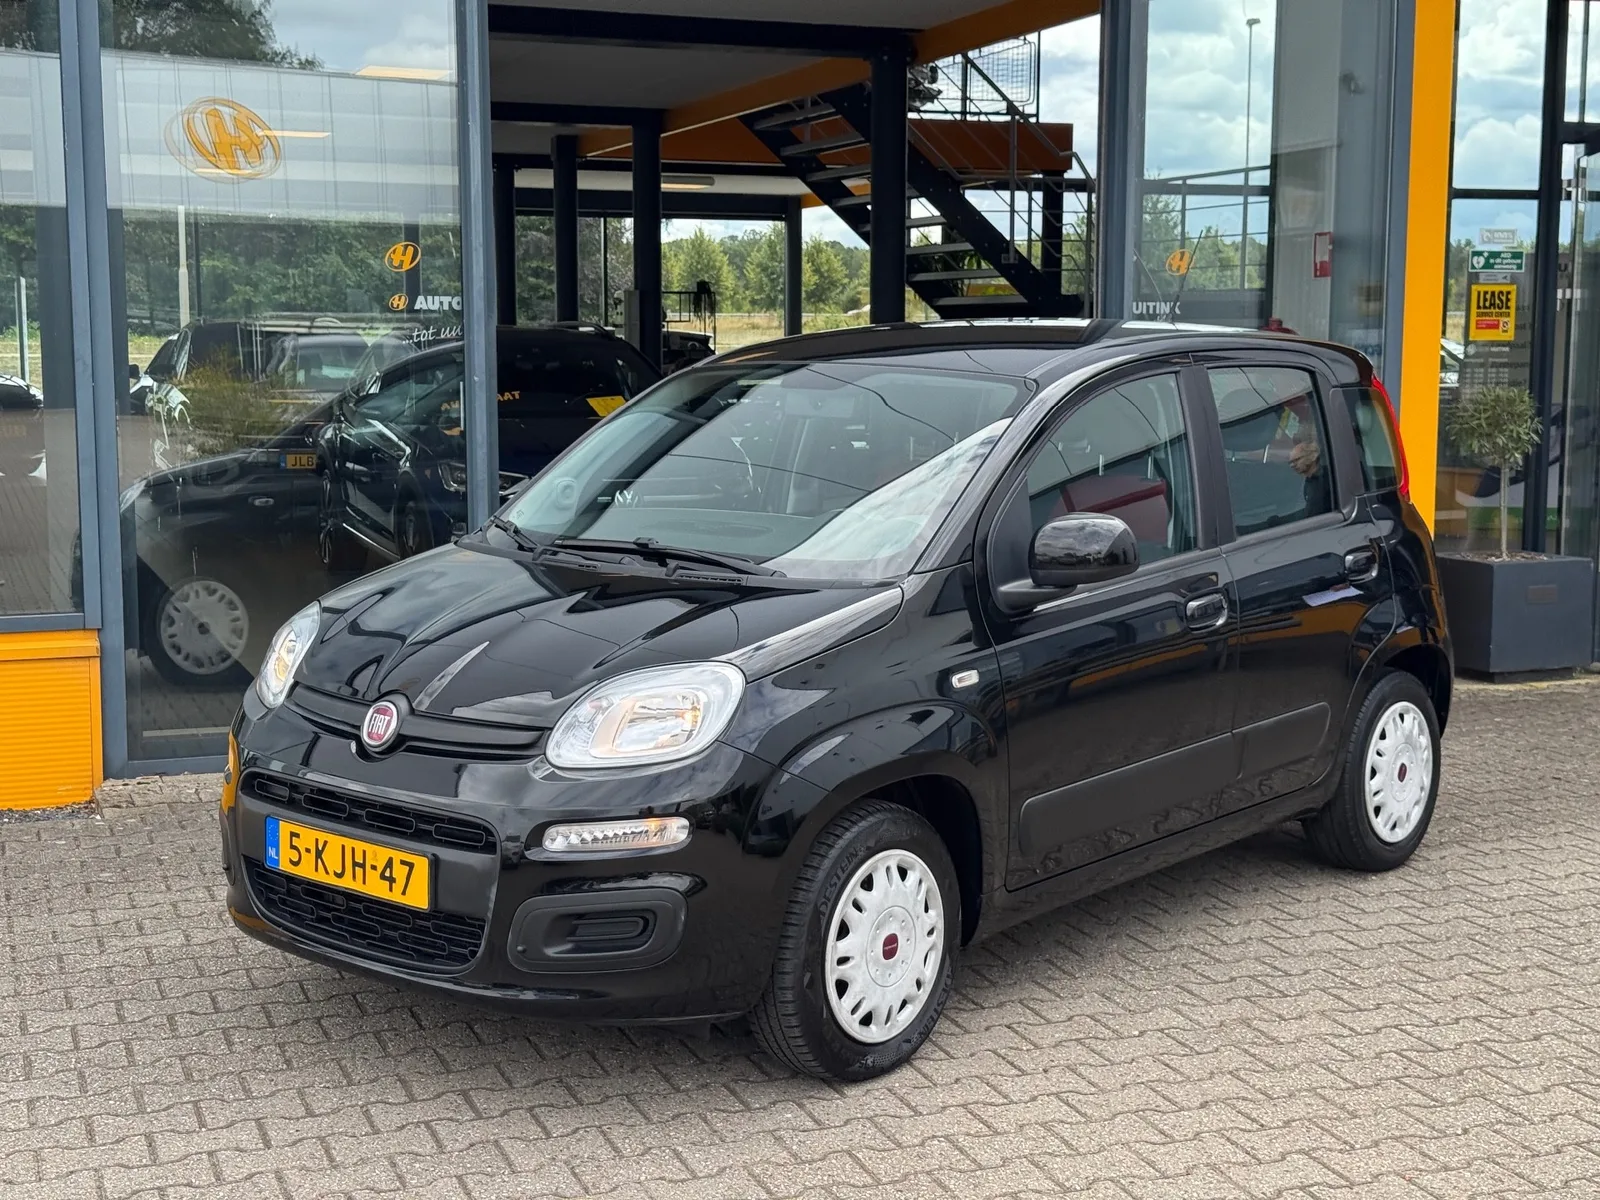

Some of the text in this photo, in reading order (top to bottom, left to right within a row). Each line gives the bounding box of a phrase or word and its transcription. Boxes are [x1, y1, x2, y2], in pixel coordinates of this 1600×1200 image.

[1476, 290, 1511, 310] LEASE
[368, 713, 391, 735] FIAT
[268, 847, 279, 860] NL
[288, 830, 416, 897] 5-KJH-47
